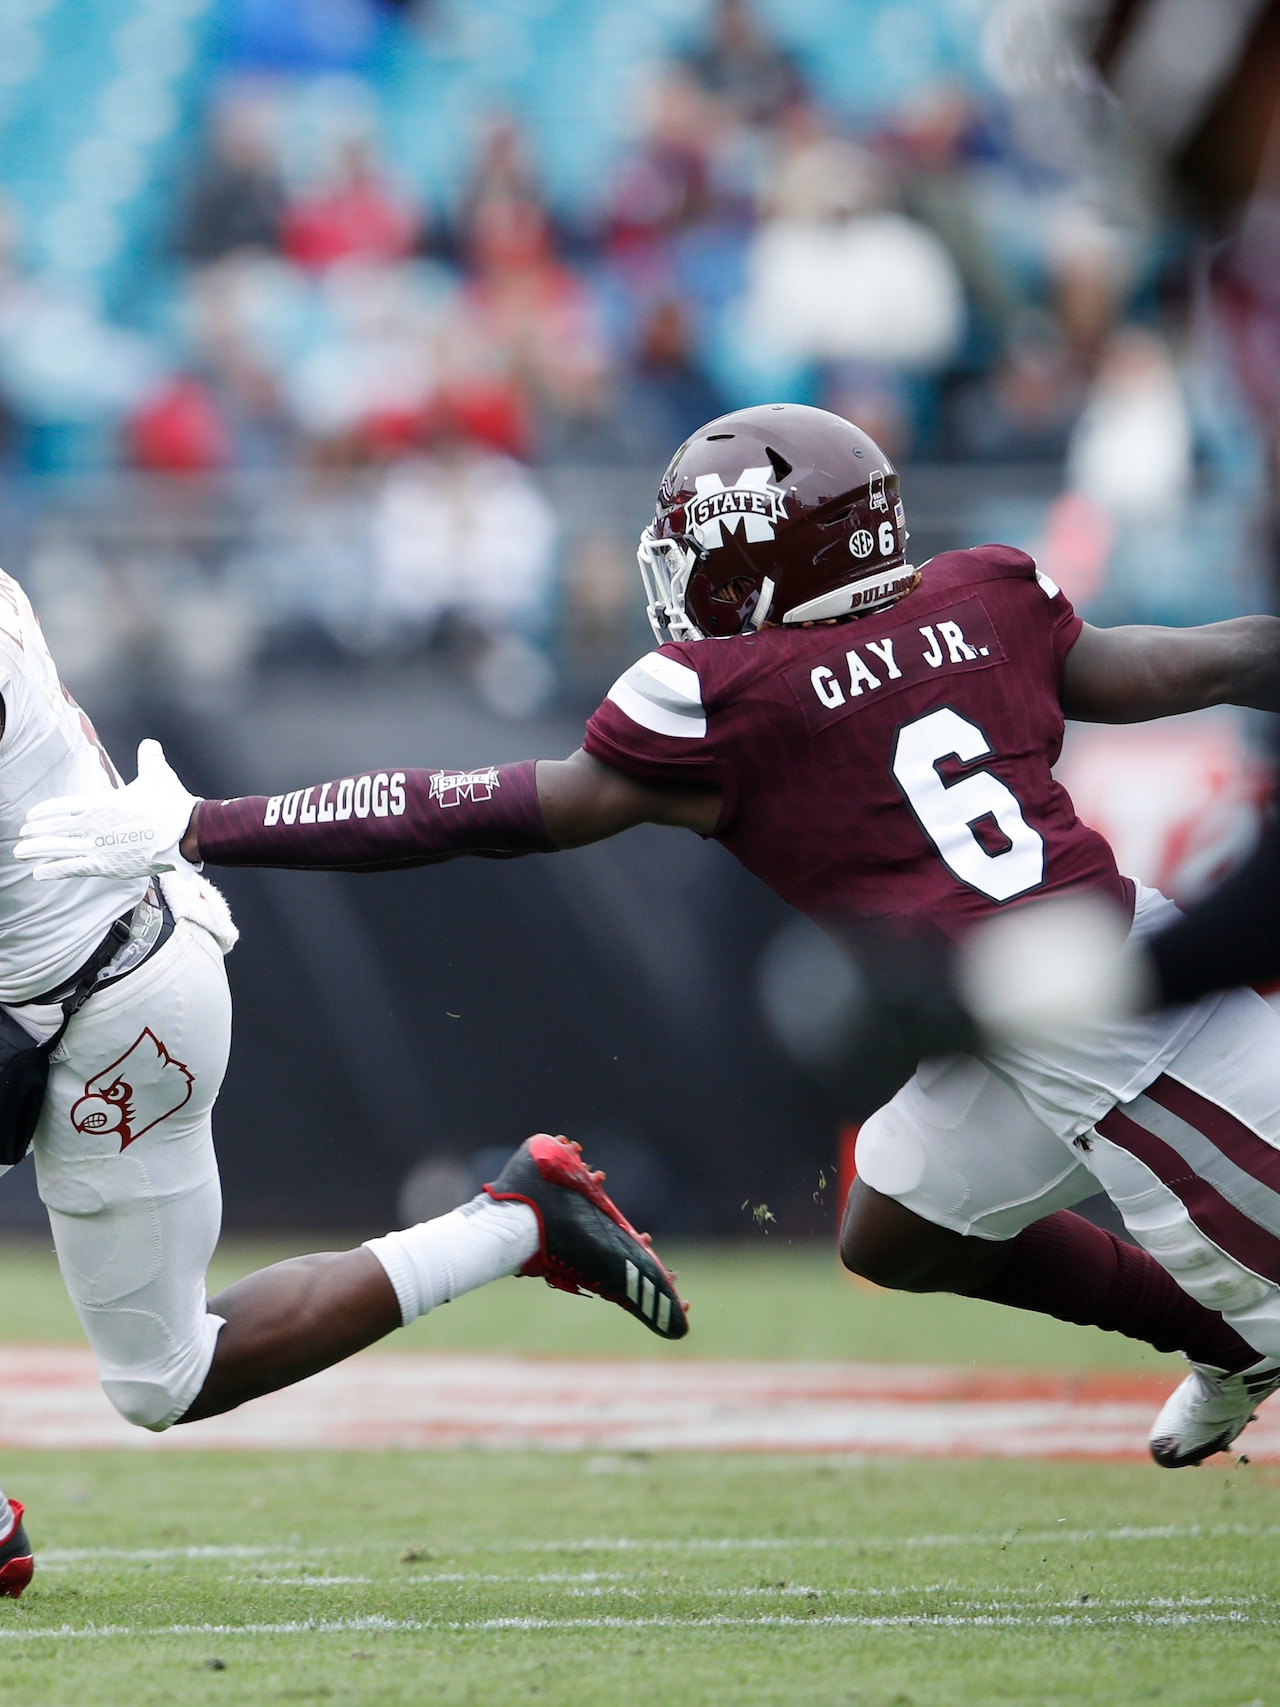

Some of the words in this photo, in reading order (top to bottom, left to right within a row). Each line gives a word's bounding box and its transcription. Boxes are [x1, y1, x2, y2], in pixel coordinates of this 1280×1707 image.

[698, 491, 767, 523] STATE
[851, 531, 872, 556] SEC
[878, 521, 895, 557] 6
[811, 637, 902, 710] GAY
[918, 620, 990, 669] JR.
[442, 774, 485, 788] STATE
[263, 771, 407, 828] BULLDOGS
[891, 706, 1046, 904] 6
[94, 829, 155, 848] adizero
